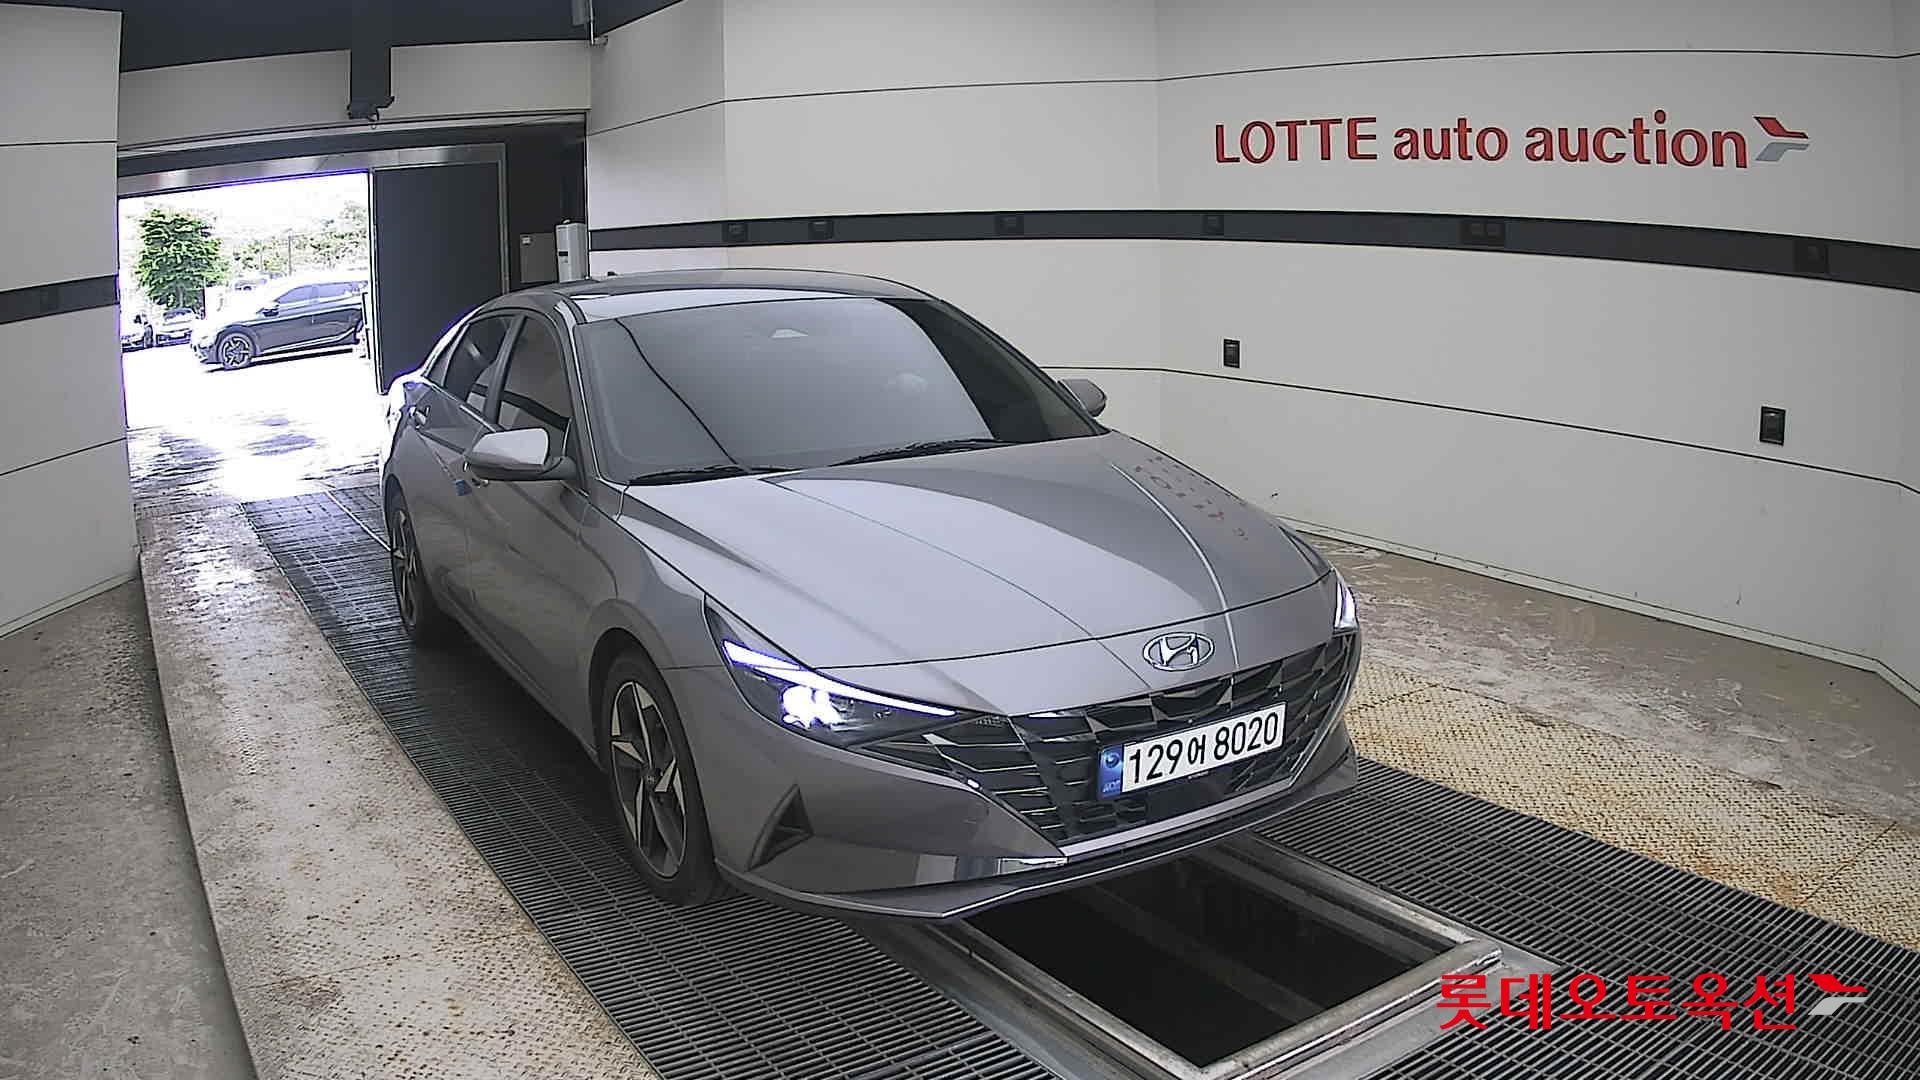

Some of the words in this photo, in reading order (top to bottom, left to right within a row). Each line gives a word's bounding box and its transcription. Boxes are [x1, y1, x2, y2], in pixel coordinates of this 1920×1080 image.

[1215, 117, 1377, 164] LOTTE
[1392, 117, 1508, 161] auto
[1524, 109, 1748, 169] auction
[1129, 734, 1207, 784] 129어
[1213, 711, 1279, 761] 8020
